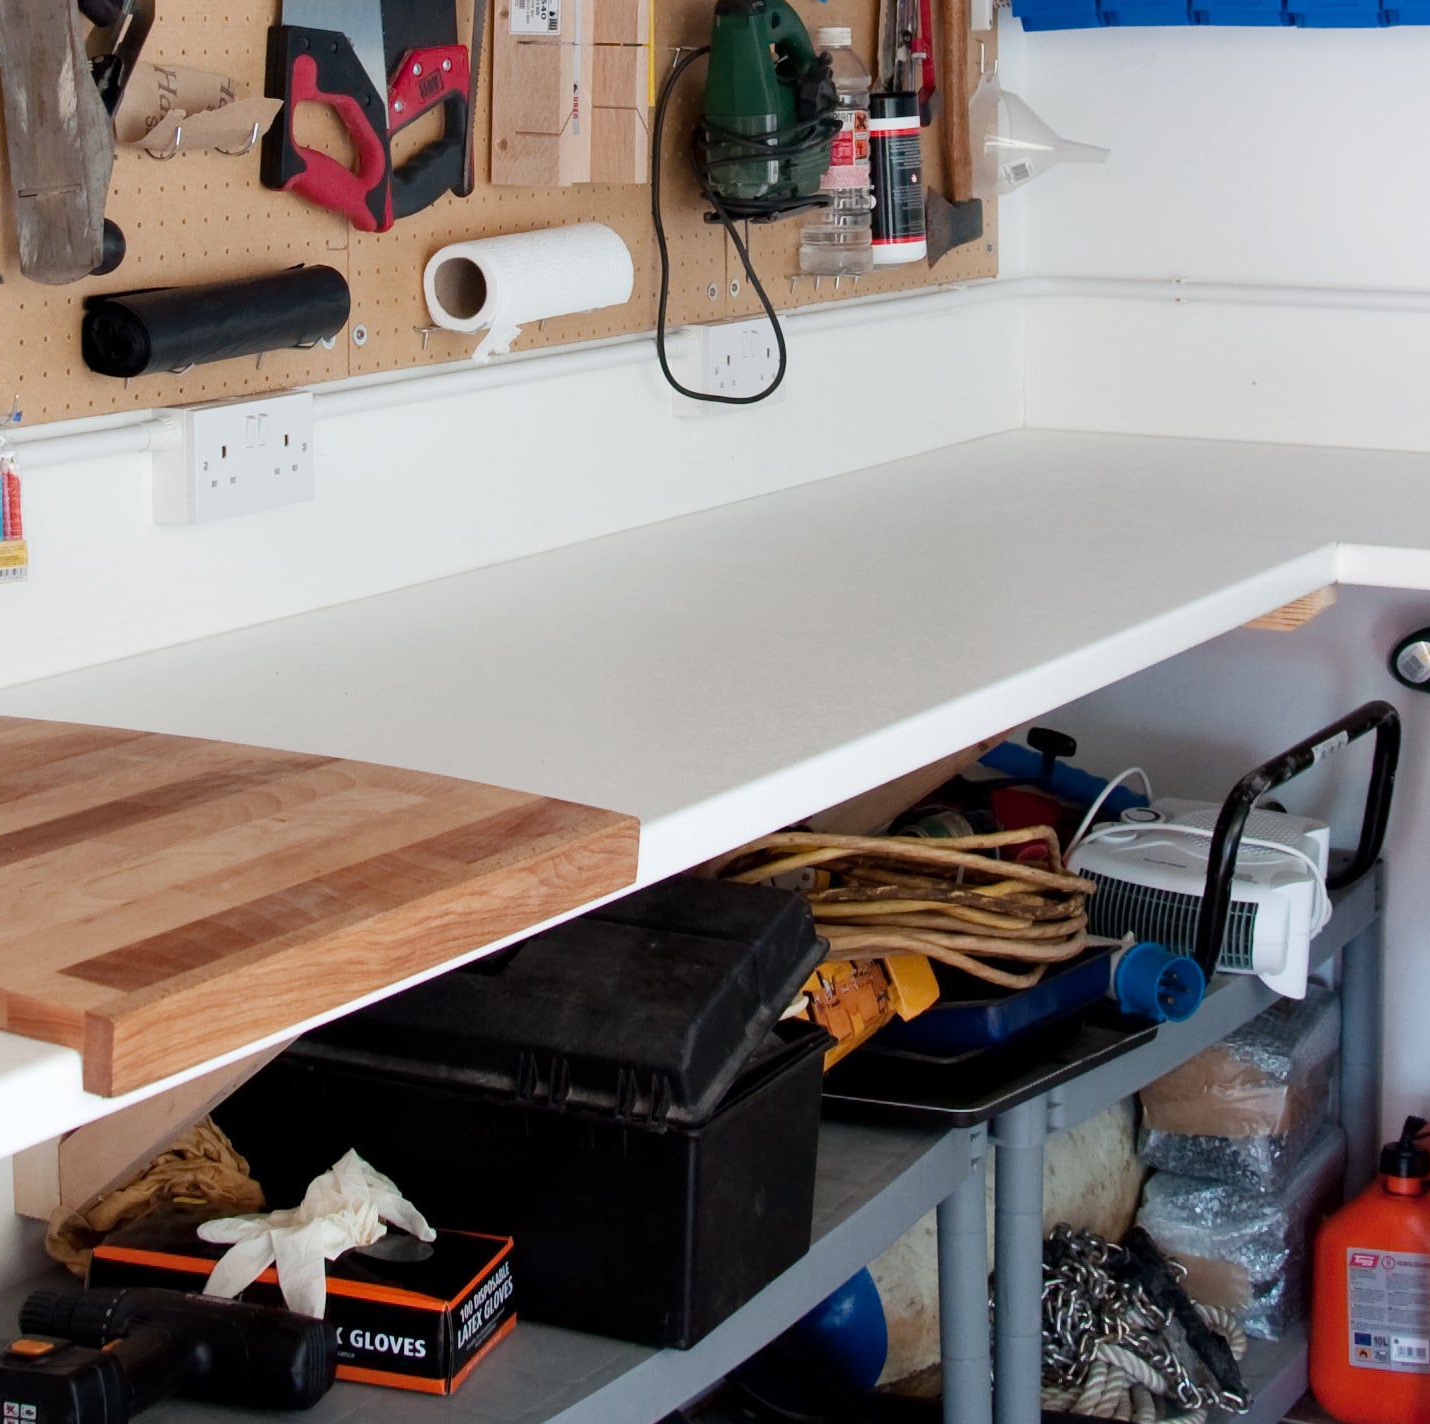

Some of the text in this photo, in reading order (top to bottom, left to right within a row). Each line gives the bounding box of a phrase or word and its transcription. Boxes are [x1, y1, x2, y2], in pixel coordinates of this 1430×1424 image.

[831, 112, 854, 123] PIRIT
[457, 1310, 483, 1349] LATEX
[484, 1276, 513, 1320] GLOVES
[459, 1301, 473, 1323] 100
[473, 1261, 510, 1311] DISPOSABLE
[350, 1329, 427, 1358] GLOVES
